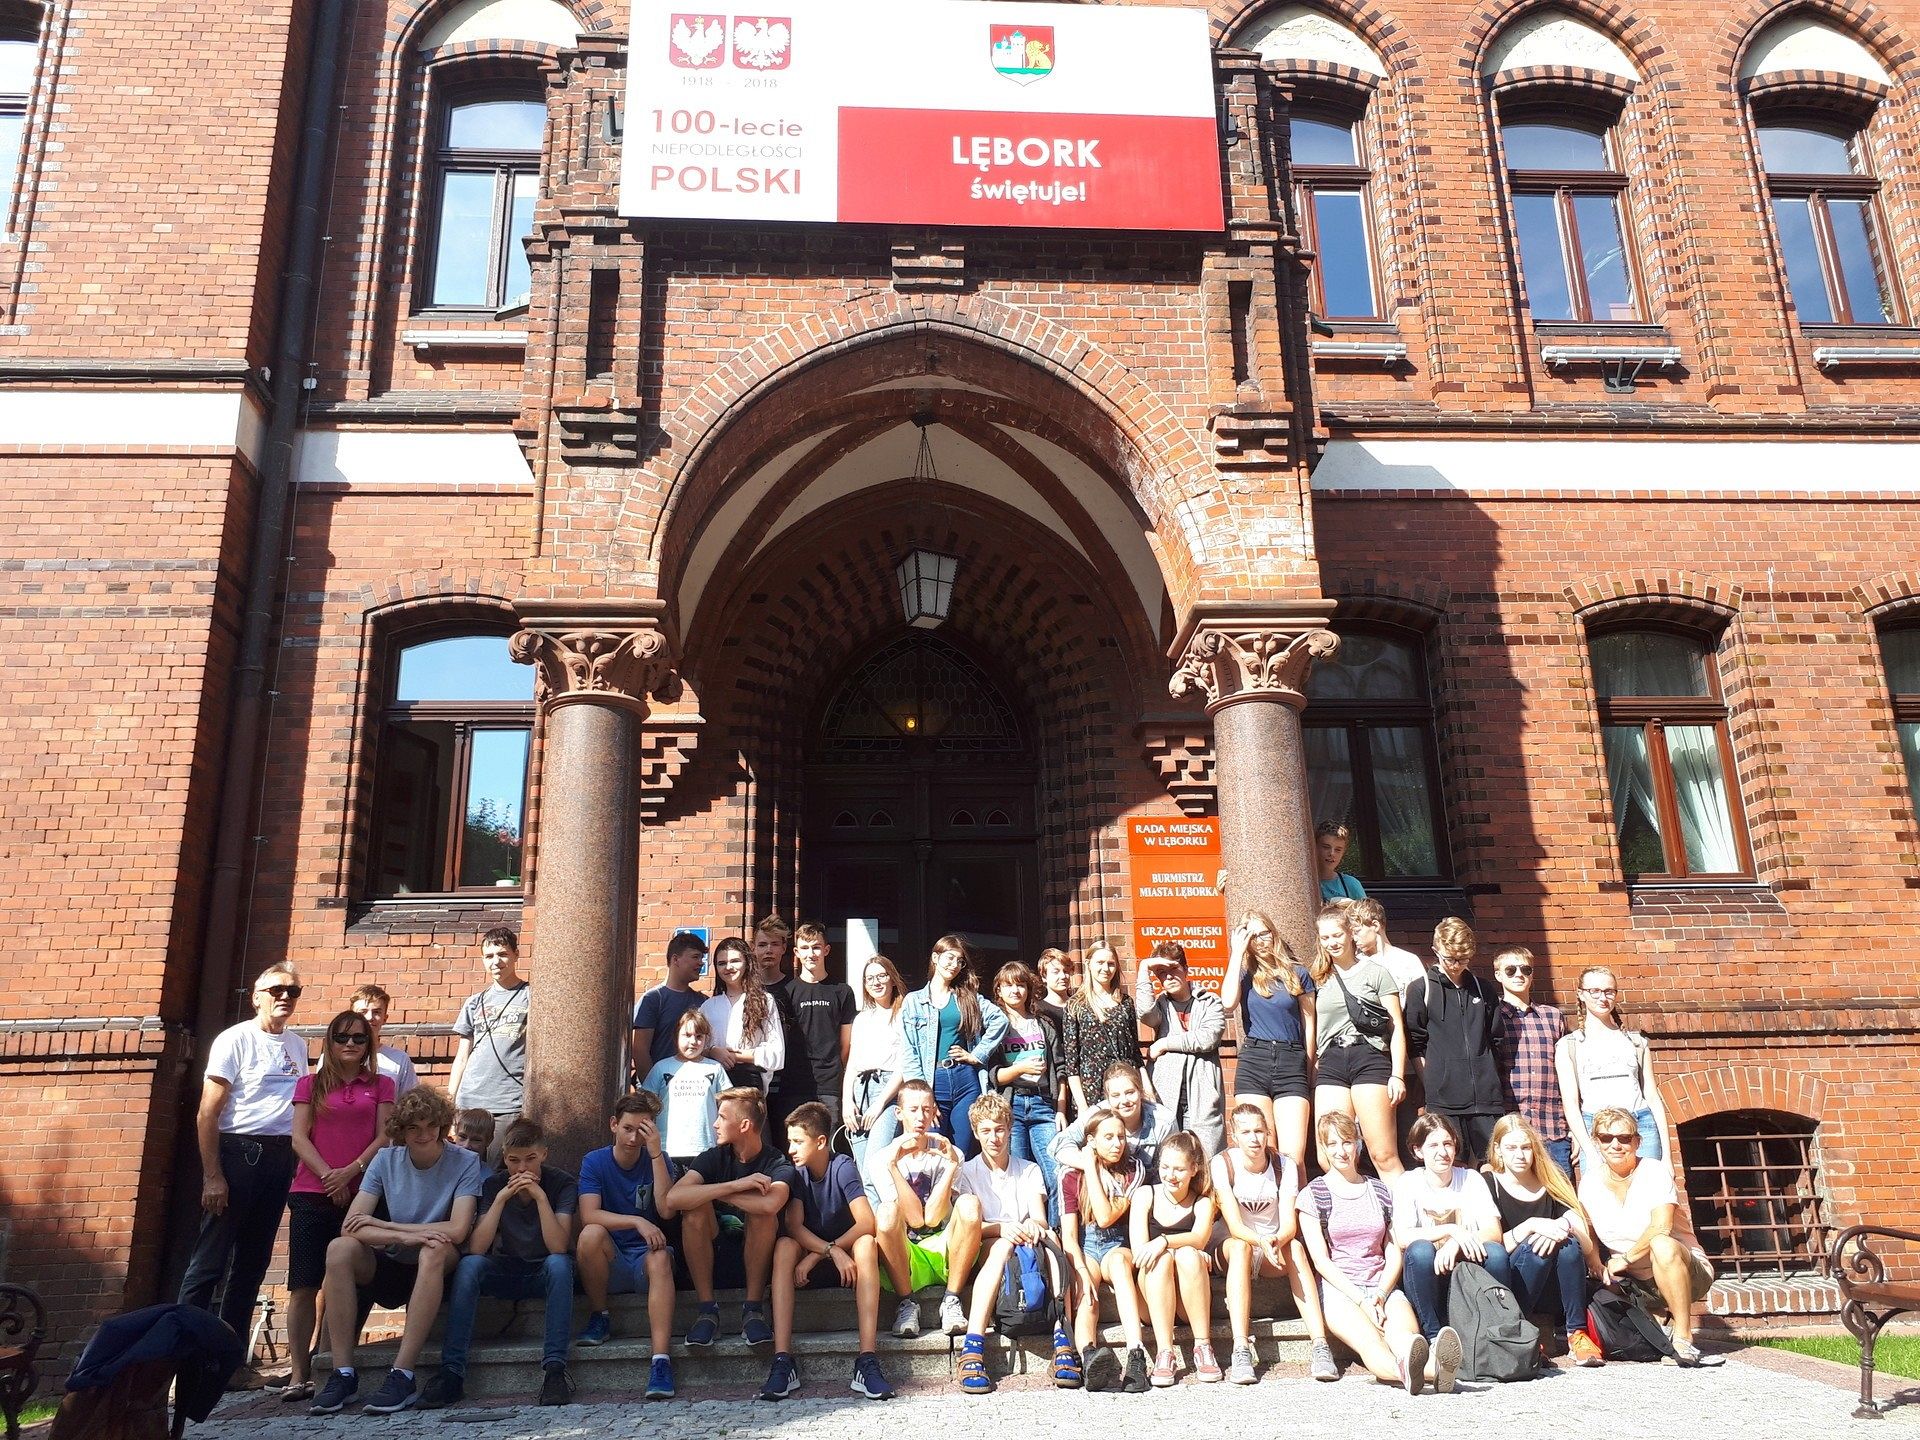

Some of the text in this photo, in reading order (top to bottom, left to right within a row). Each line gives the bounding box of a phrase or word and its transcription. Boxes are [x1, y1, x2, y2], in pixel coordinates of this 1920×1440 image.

[682, 76, 713, 86] 1918
[744, 78, 777, 88] 2018
[652, 109, 803, 137] 100-lecie
[652, 143, 802, 159] NIEPODLEGŁOŚCI
[952, 135, 1103, 172] LĘBORK
[651, 165, 801, 194] POLSKI
[970, 177, 1087, 206] świętuje!
[1135, 824, 1213, 836] RADA MIEJSKA
[1144, 836, 1208, 848] W LĘBORKU
[1151, 872, 1205, 883] BURMISTRZ
[1139, 886, 1219, 900] MIASTA LĘBORKA
[1141, 926, 1222, 939] URZĄD MIEJSKI
[1187, 966, 1224, 977] STANU
